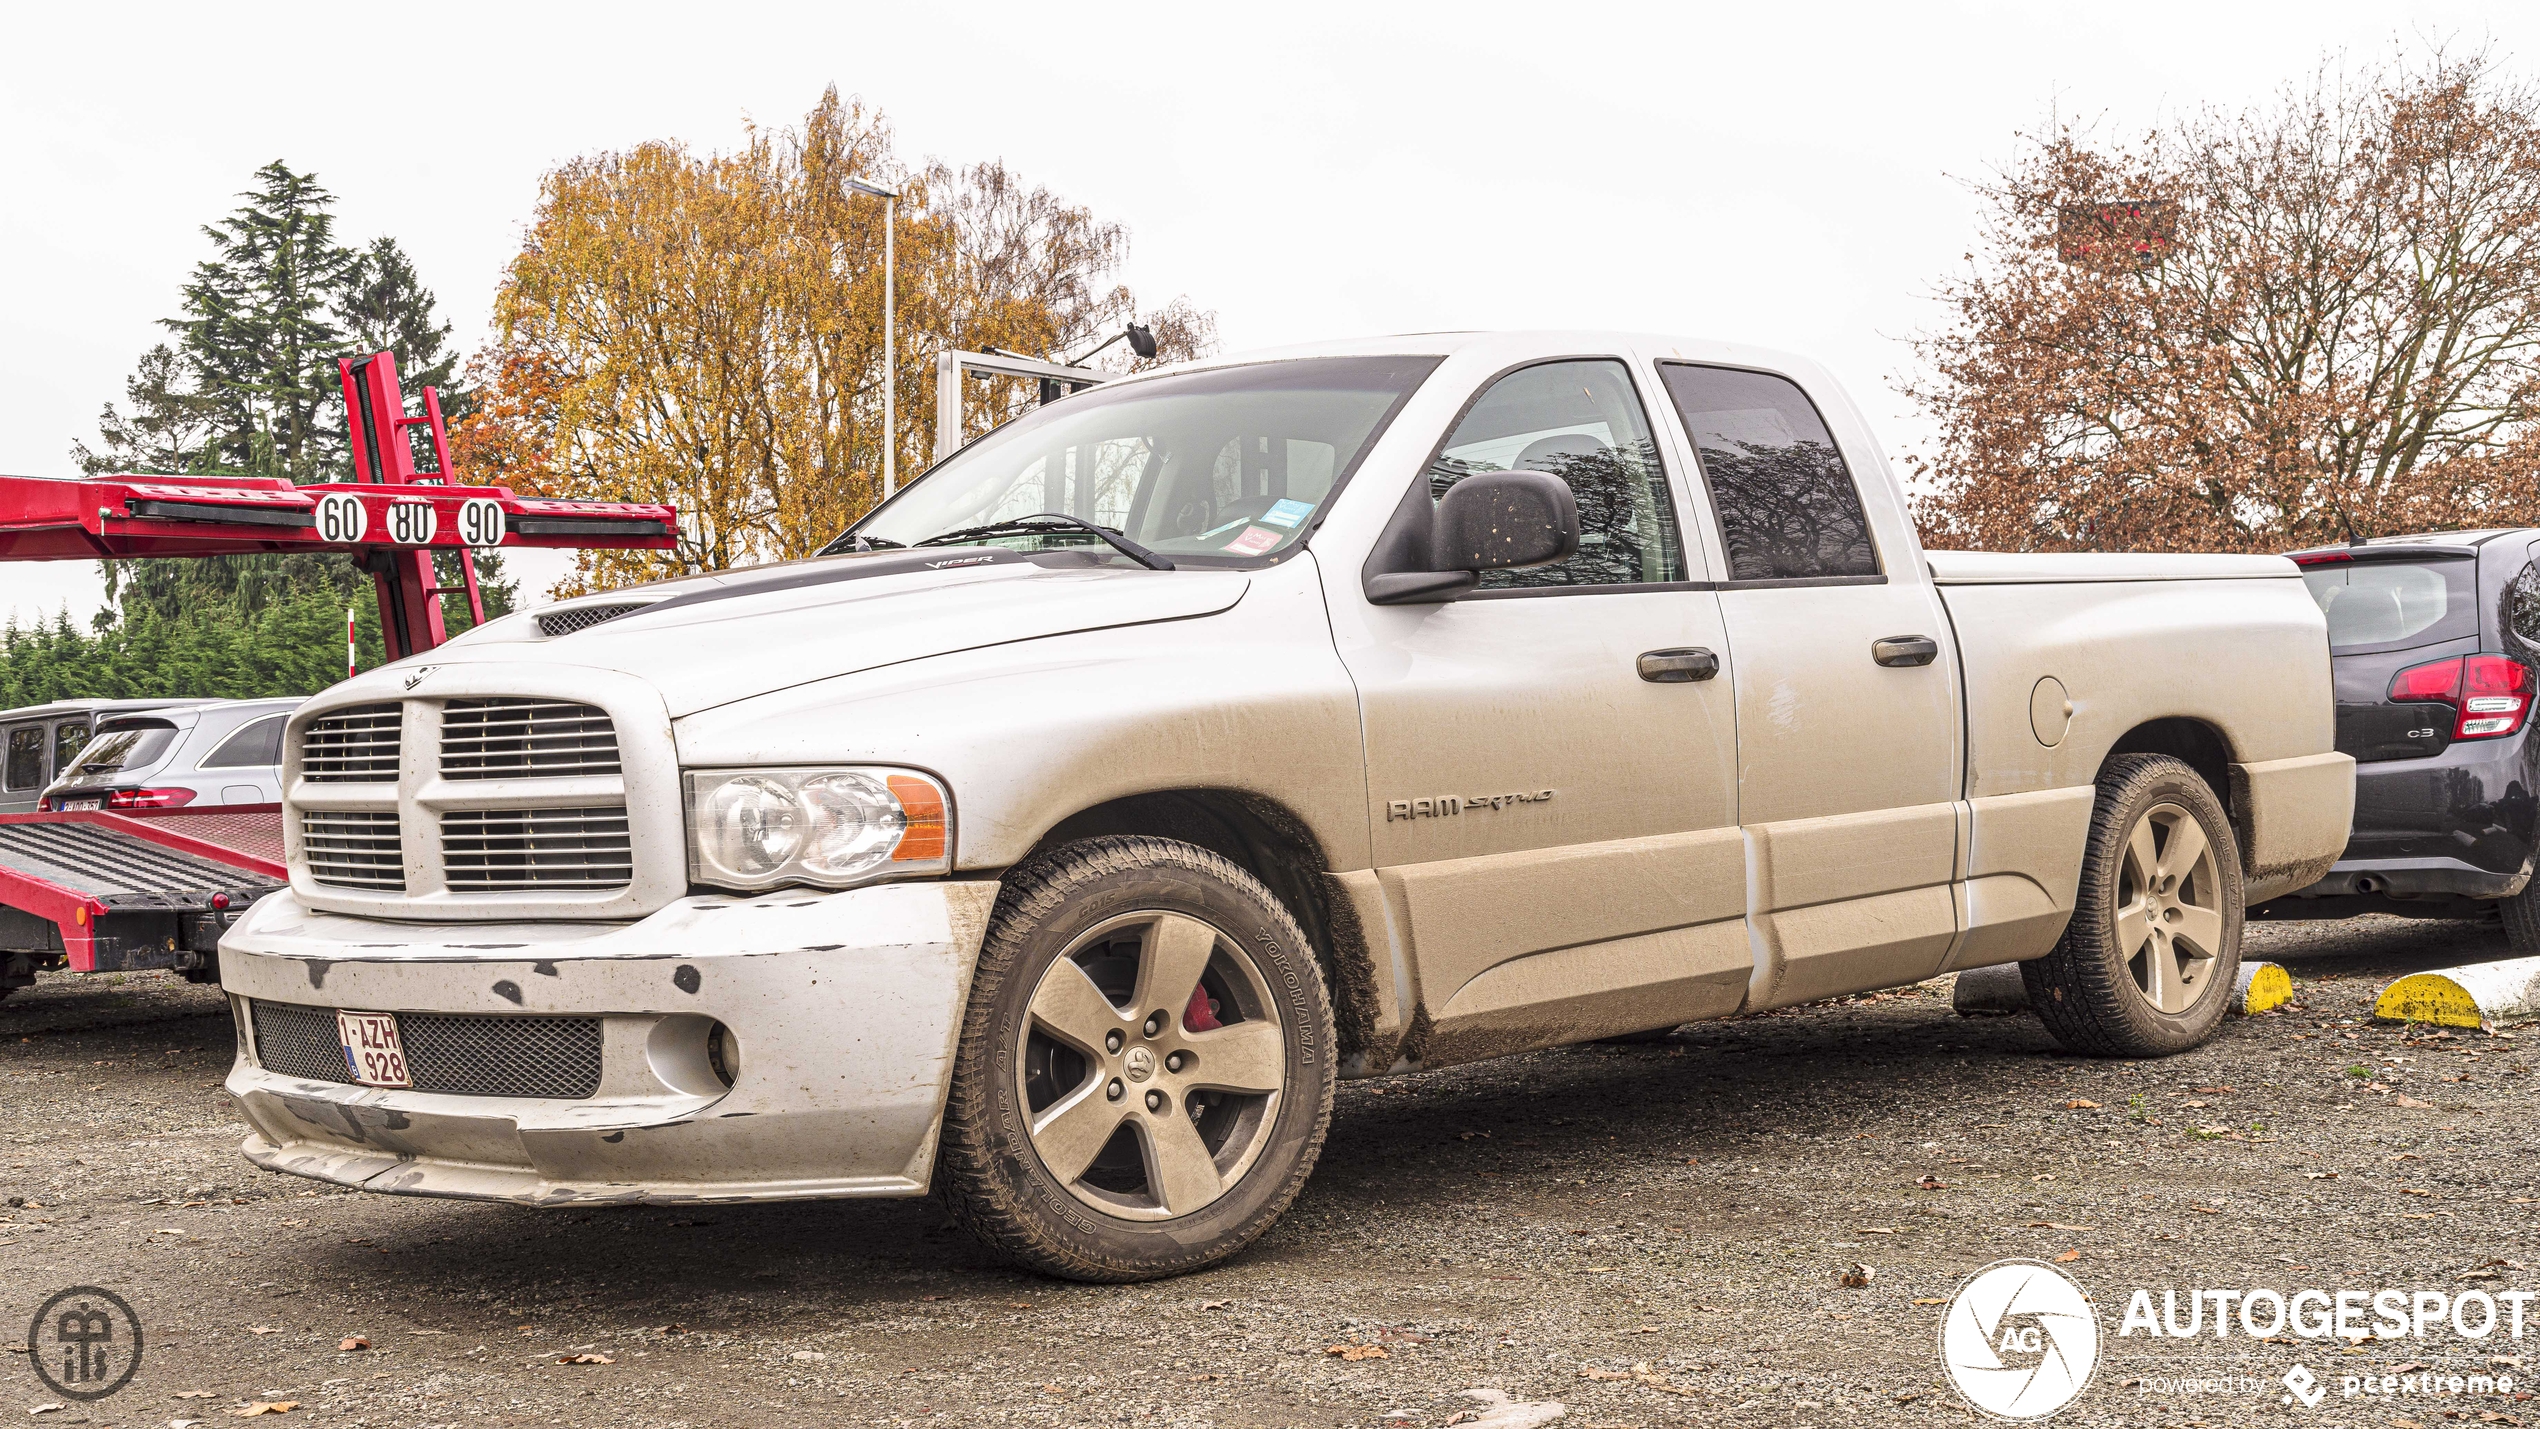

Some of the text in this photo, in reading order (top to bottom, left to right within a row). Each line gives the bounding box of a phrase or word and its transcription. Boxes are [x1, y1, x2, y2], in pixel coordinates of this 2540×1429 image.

[324, 497, 358, 541] 60
[395, 503, 429, 543] 80
[466, 502, 499, 545] 90
[925, 555, 994, 569] VIPER
[2407, 728, 2435, 738] C3
[1386, 788, 1557, 822] RAM SRT-10
[1255, 926, 1315, 1065] YOKOHAMA
[364, 1051, 406, 1082] 928
[997, 1089, 1097, 1235] GEOLANDAR
